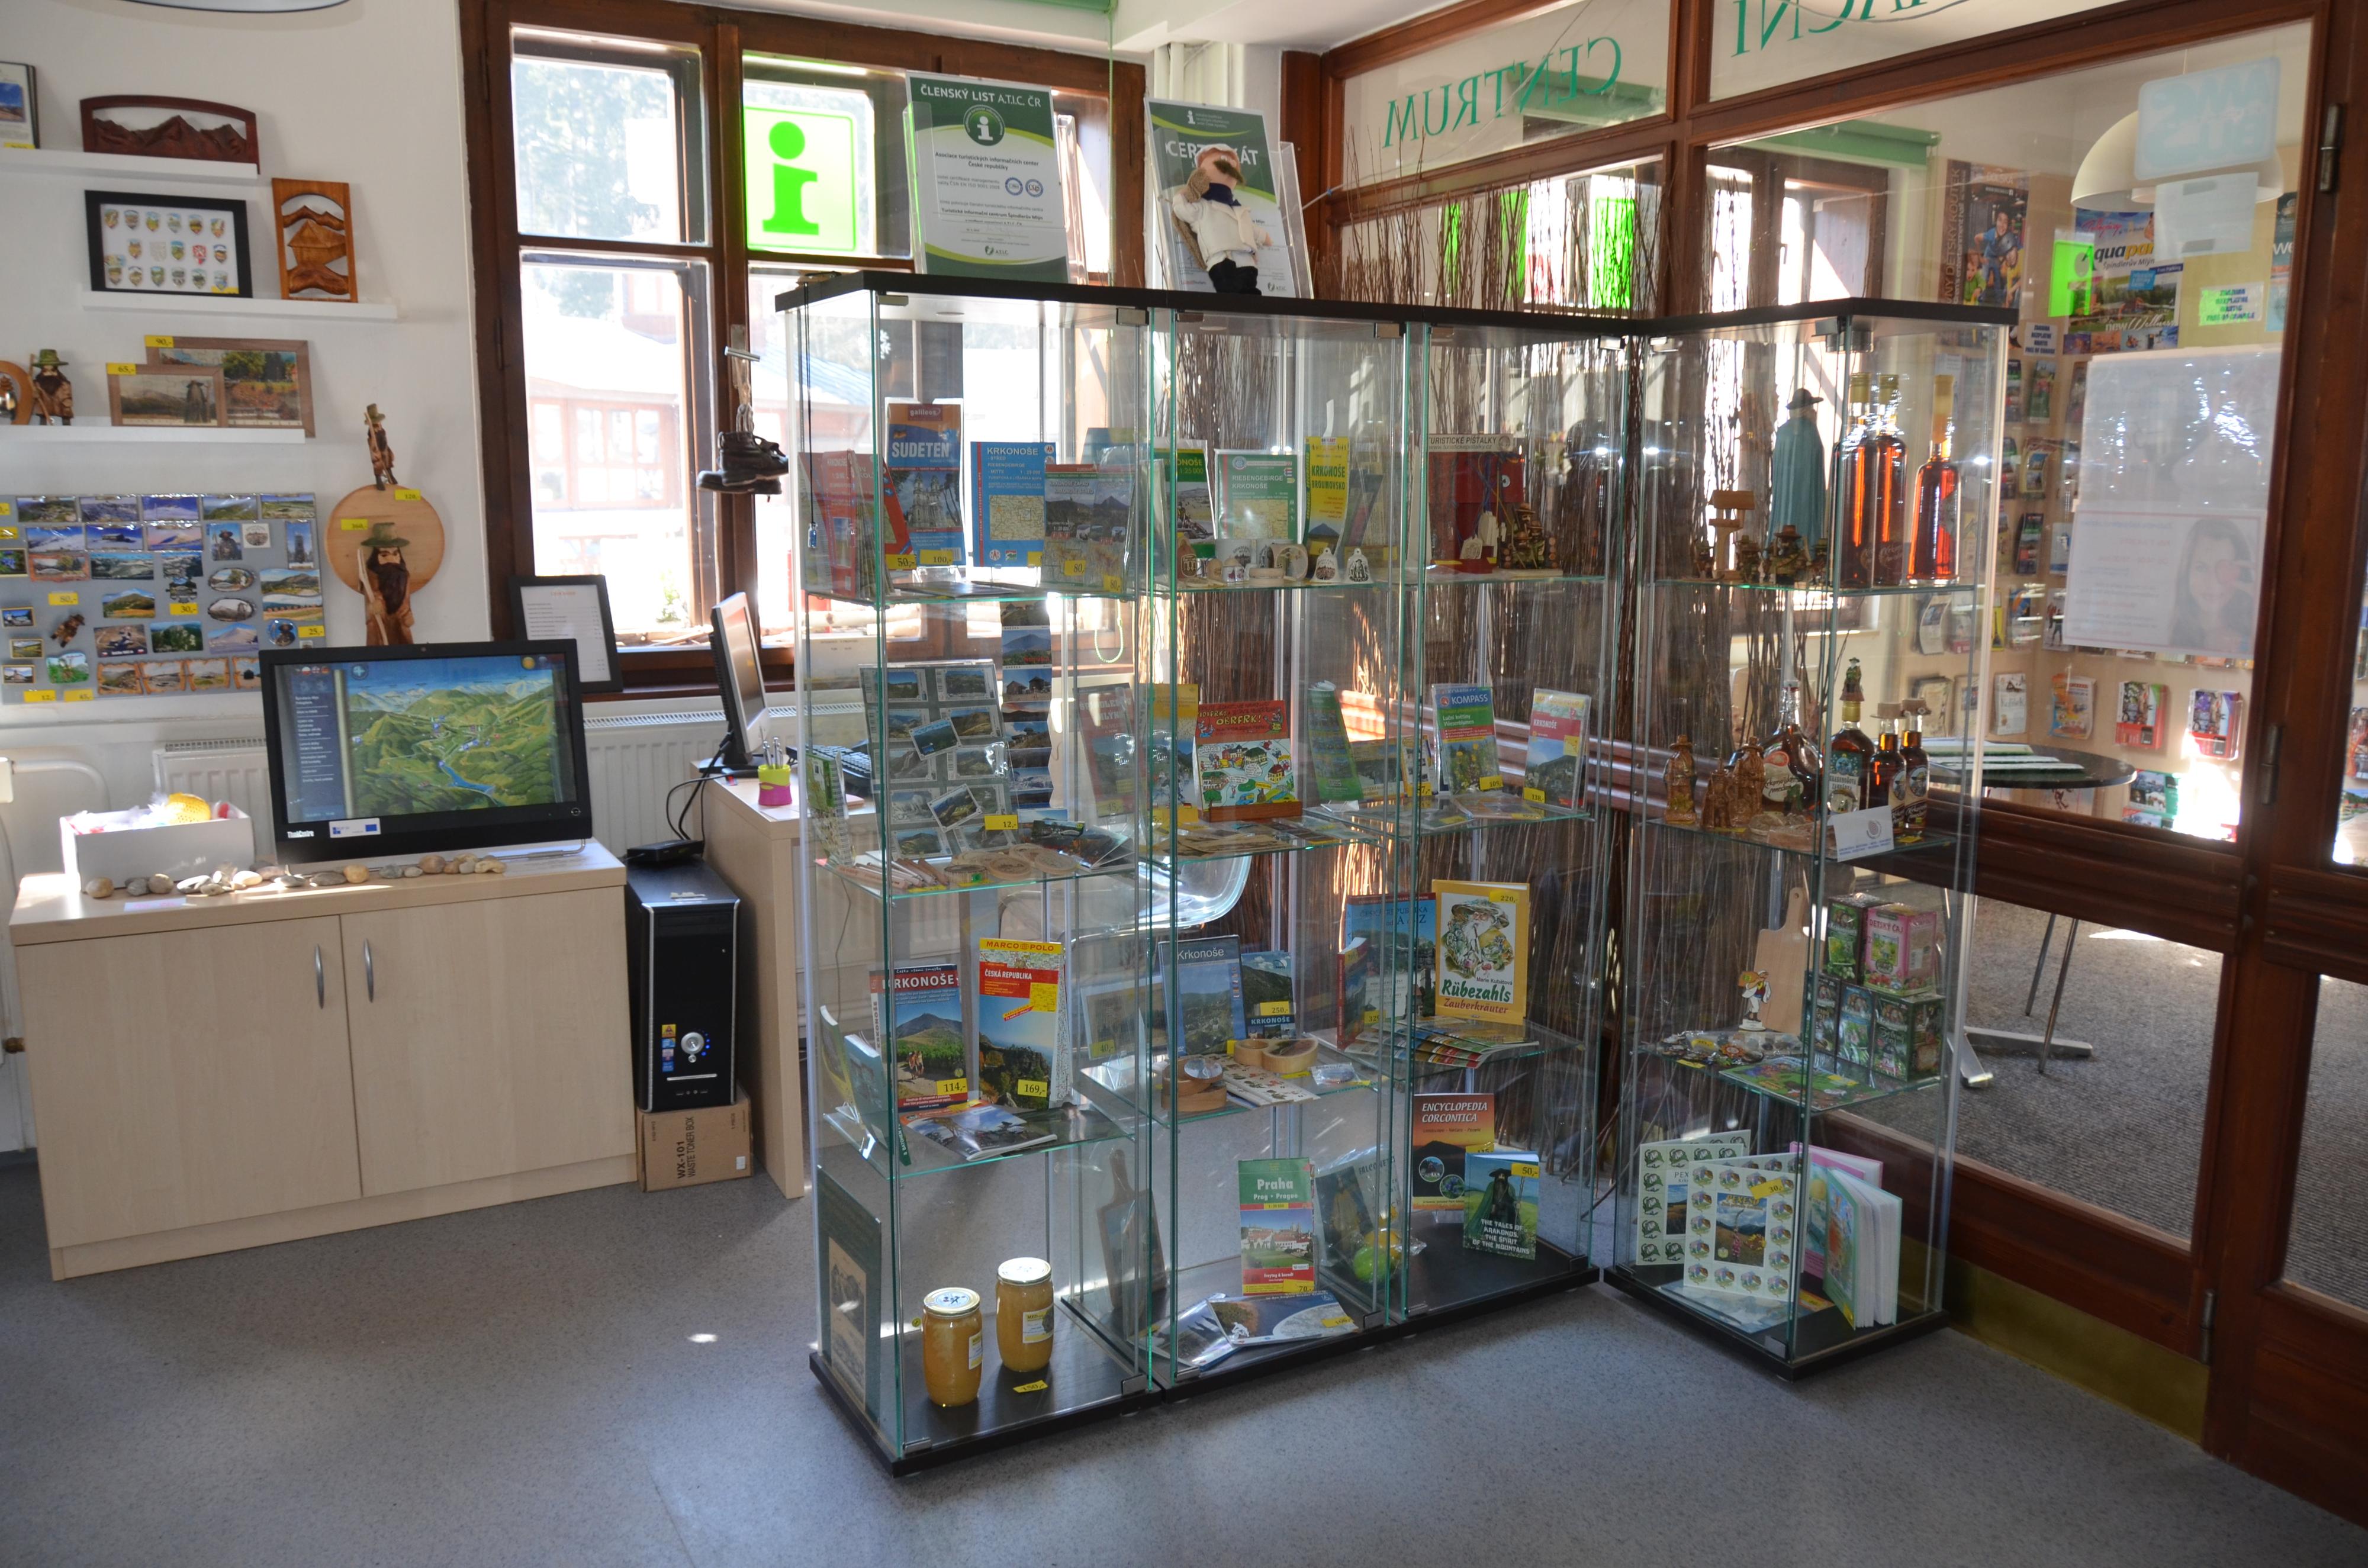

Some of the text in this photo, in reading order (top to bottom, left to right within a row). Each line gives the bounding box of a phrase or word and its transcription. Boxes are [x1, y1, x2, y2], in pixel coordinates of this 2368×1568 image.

[921, 83, 1041, 107] ČLENSKÝ LIST A.T.I.C. ČR
[958, 154, 988, 163] turistických
[2082, 243, 2154, 271] Aquapar
[2106, 321, 2128, 332] new
[892, 441, 950, 458] SUDETEN
[987, 446, 1038, 455] KRKONOŠE
[1312, 464, 1345, 478] KRKONOŠE
[1312, 480, 1345, 490] BROUMOVSKO
[897, 558, 915, 568] 50,-
[1452, 694, 1488, 704] KOMPASS
[1534, 719, 1558, 729] KRKONOŠE
[1501, 894, 1518, 903] 220,-
[1419, 915, 1427, 923] Z
[1177, 947, 1224, 961] Krkonoše
[985, 968, 1032, 980] ČESKÁ REPUBLIKA
[1442, 979, 1511, 1003] Rübezahls
[1272, 1006, 1288, 1015] 250,-
[1444, 998, 1508, 1014] Zauberkräuter
[1251, 1016, 1291, 1025] KRKONOŠE
[1100, 1044, 1114, 1053] 40,-
[944, 1082, 966, 1092] 114,-
[1025, 1084, 1045, 1095] 169,-
[1422, 1102, 1487, 1112] ENCYCLOPEDIA
[1422, 1113, 1478, 1123] CORCONTICA
[686, 1116, 696, 1178] WASTE TONER BOX
[677, 1141, 686, 1179] WX-101
[1522, 1166, 1537, 1176] 50,-
[1257, 1177, 1293, 1190] Praha
[1726, 1194, 1759, 1205] PEXESO
[1481, 1218, 1493, 1227] THE
[1494, 1221, 1513, 1230] TALES
[1486, 1234, 1517, 1245] THE SPIRIT
[1482, 1240, 1494, 1248] THE
[1495, 1242, 1530, 1254] MOUNTAINS
